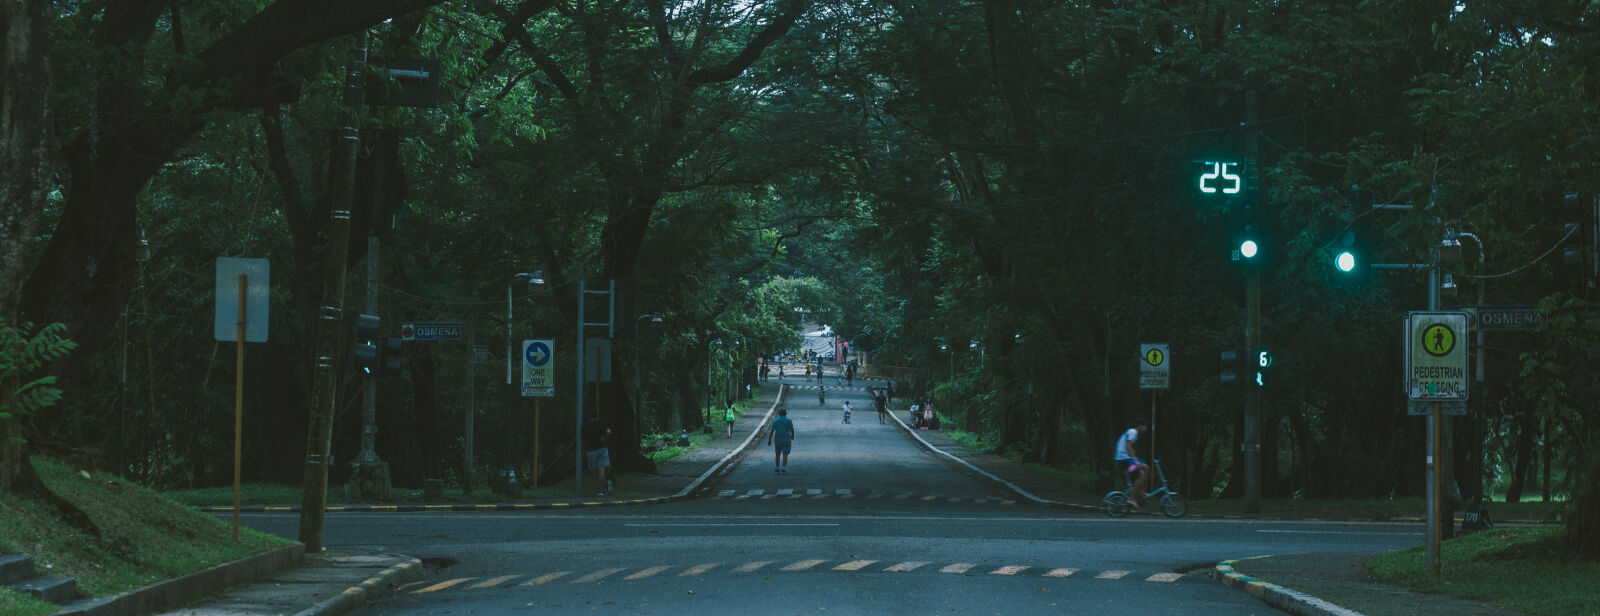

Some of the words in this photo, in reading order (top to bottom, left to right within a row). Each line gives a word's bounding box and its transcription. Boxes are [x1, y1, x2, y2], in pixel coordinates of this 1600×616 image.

[1200, 161, 1240, 194] 25
[1260, 351, 1268, 367] 6
[531, 368, 546, 376] ONE
[1414, 366, 1463, 378] PEDESTRIAN
[531, 377, 546, 385] WAY
[1419, 382, 1459, 393] CRSSING
